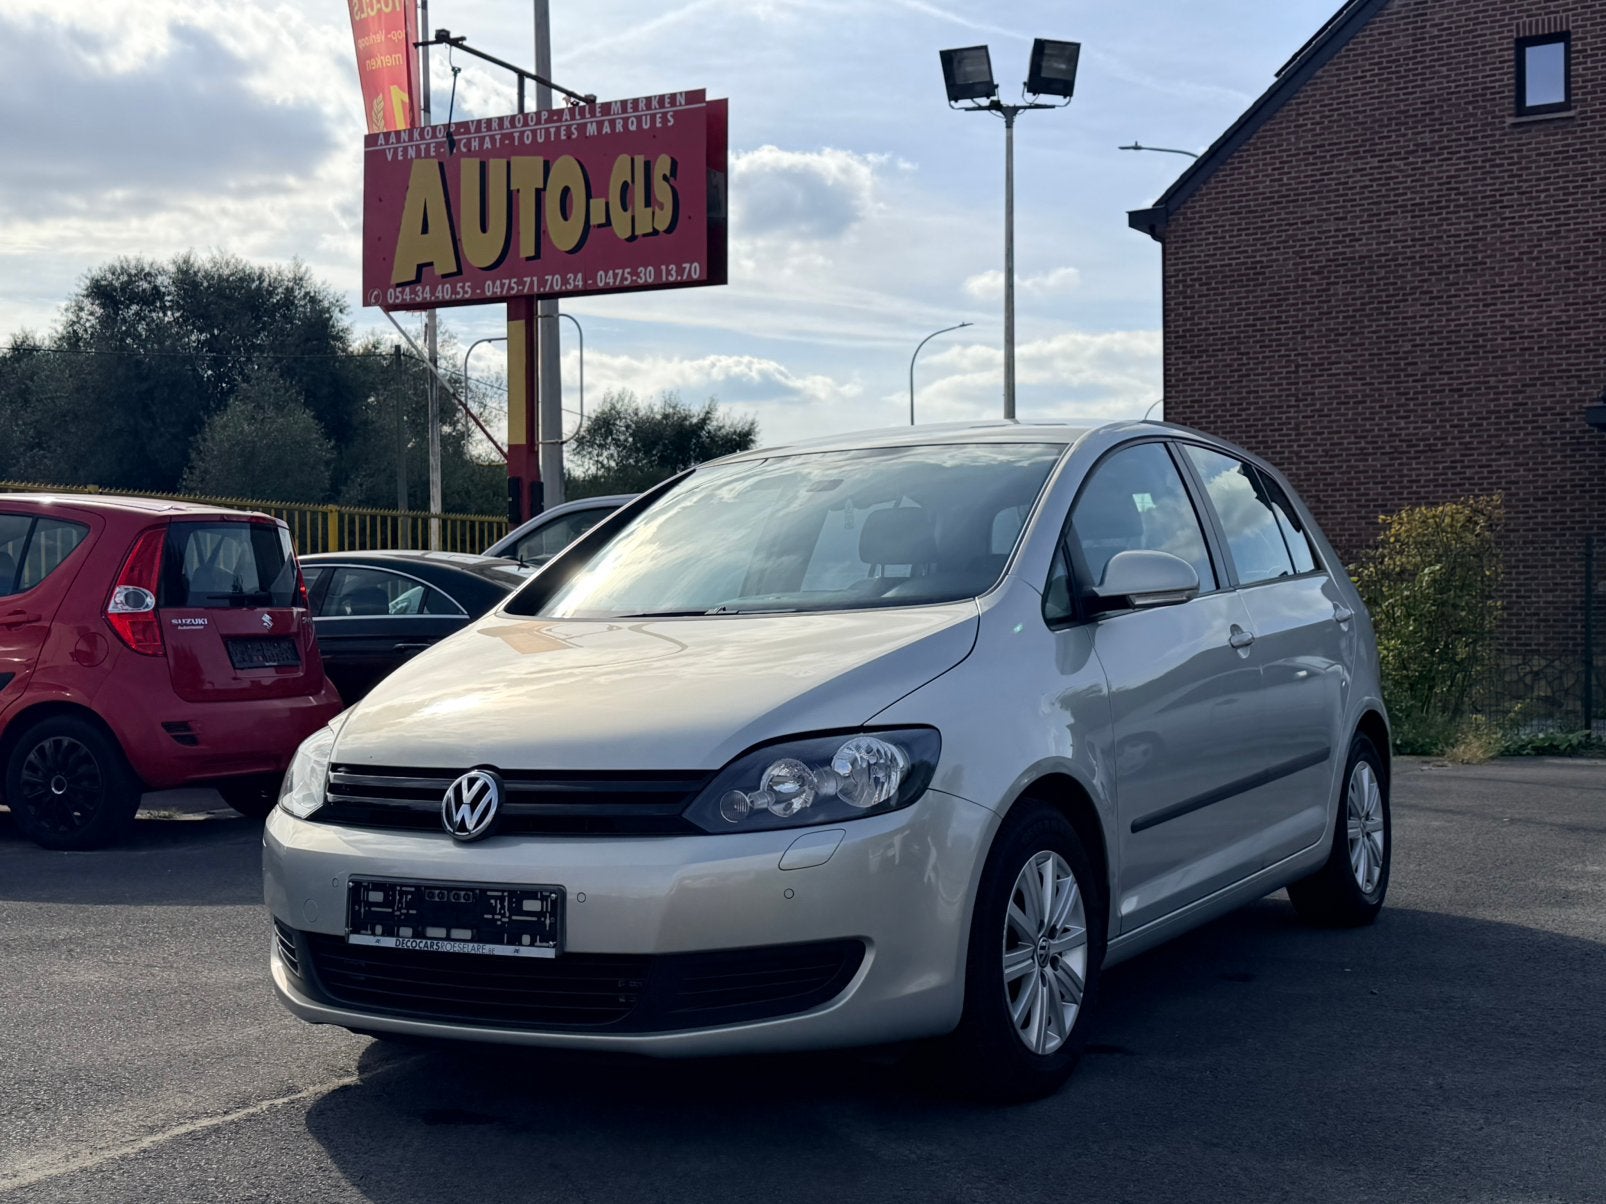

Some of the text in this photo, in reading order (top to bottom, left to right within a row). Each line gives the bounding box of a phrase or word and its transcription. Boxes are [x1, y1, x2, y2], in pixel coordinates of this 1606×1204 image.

[610, 92, 686, 115] MERKEN
[586, 112, 675, 137] MARQUES
[391, 153, 677, 286] AUTO-CLS
[387, 282, 472, 303] 054-34.40.55
[485, 273, 583, 296] 0475-71.70.34
[597, 266, 655, 287] 0475-30
[660, 262, 700, 281] 13.70
